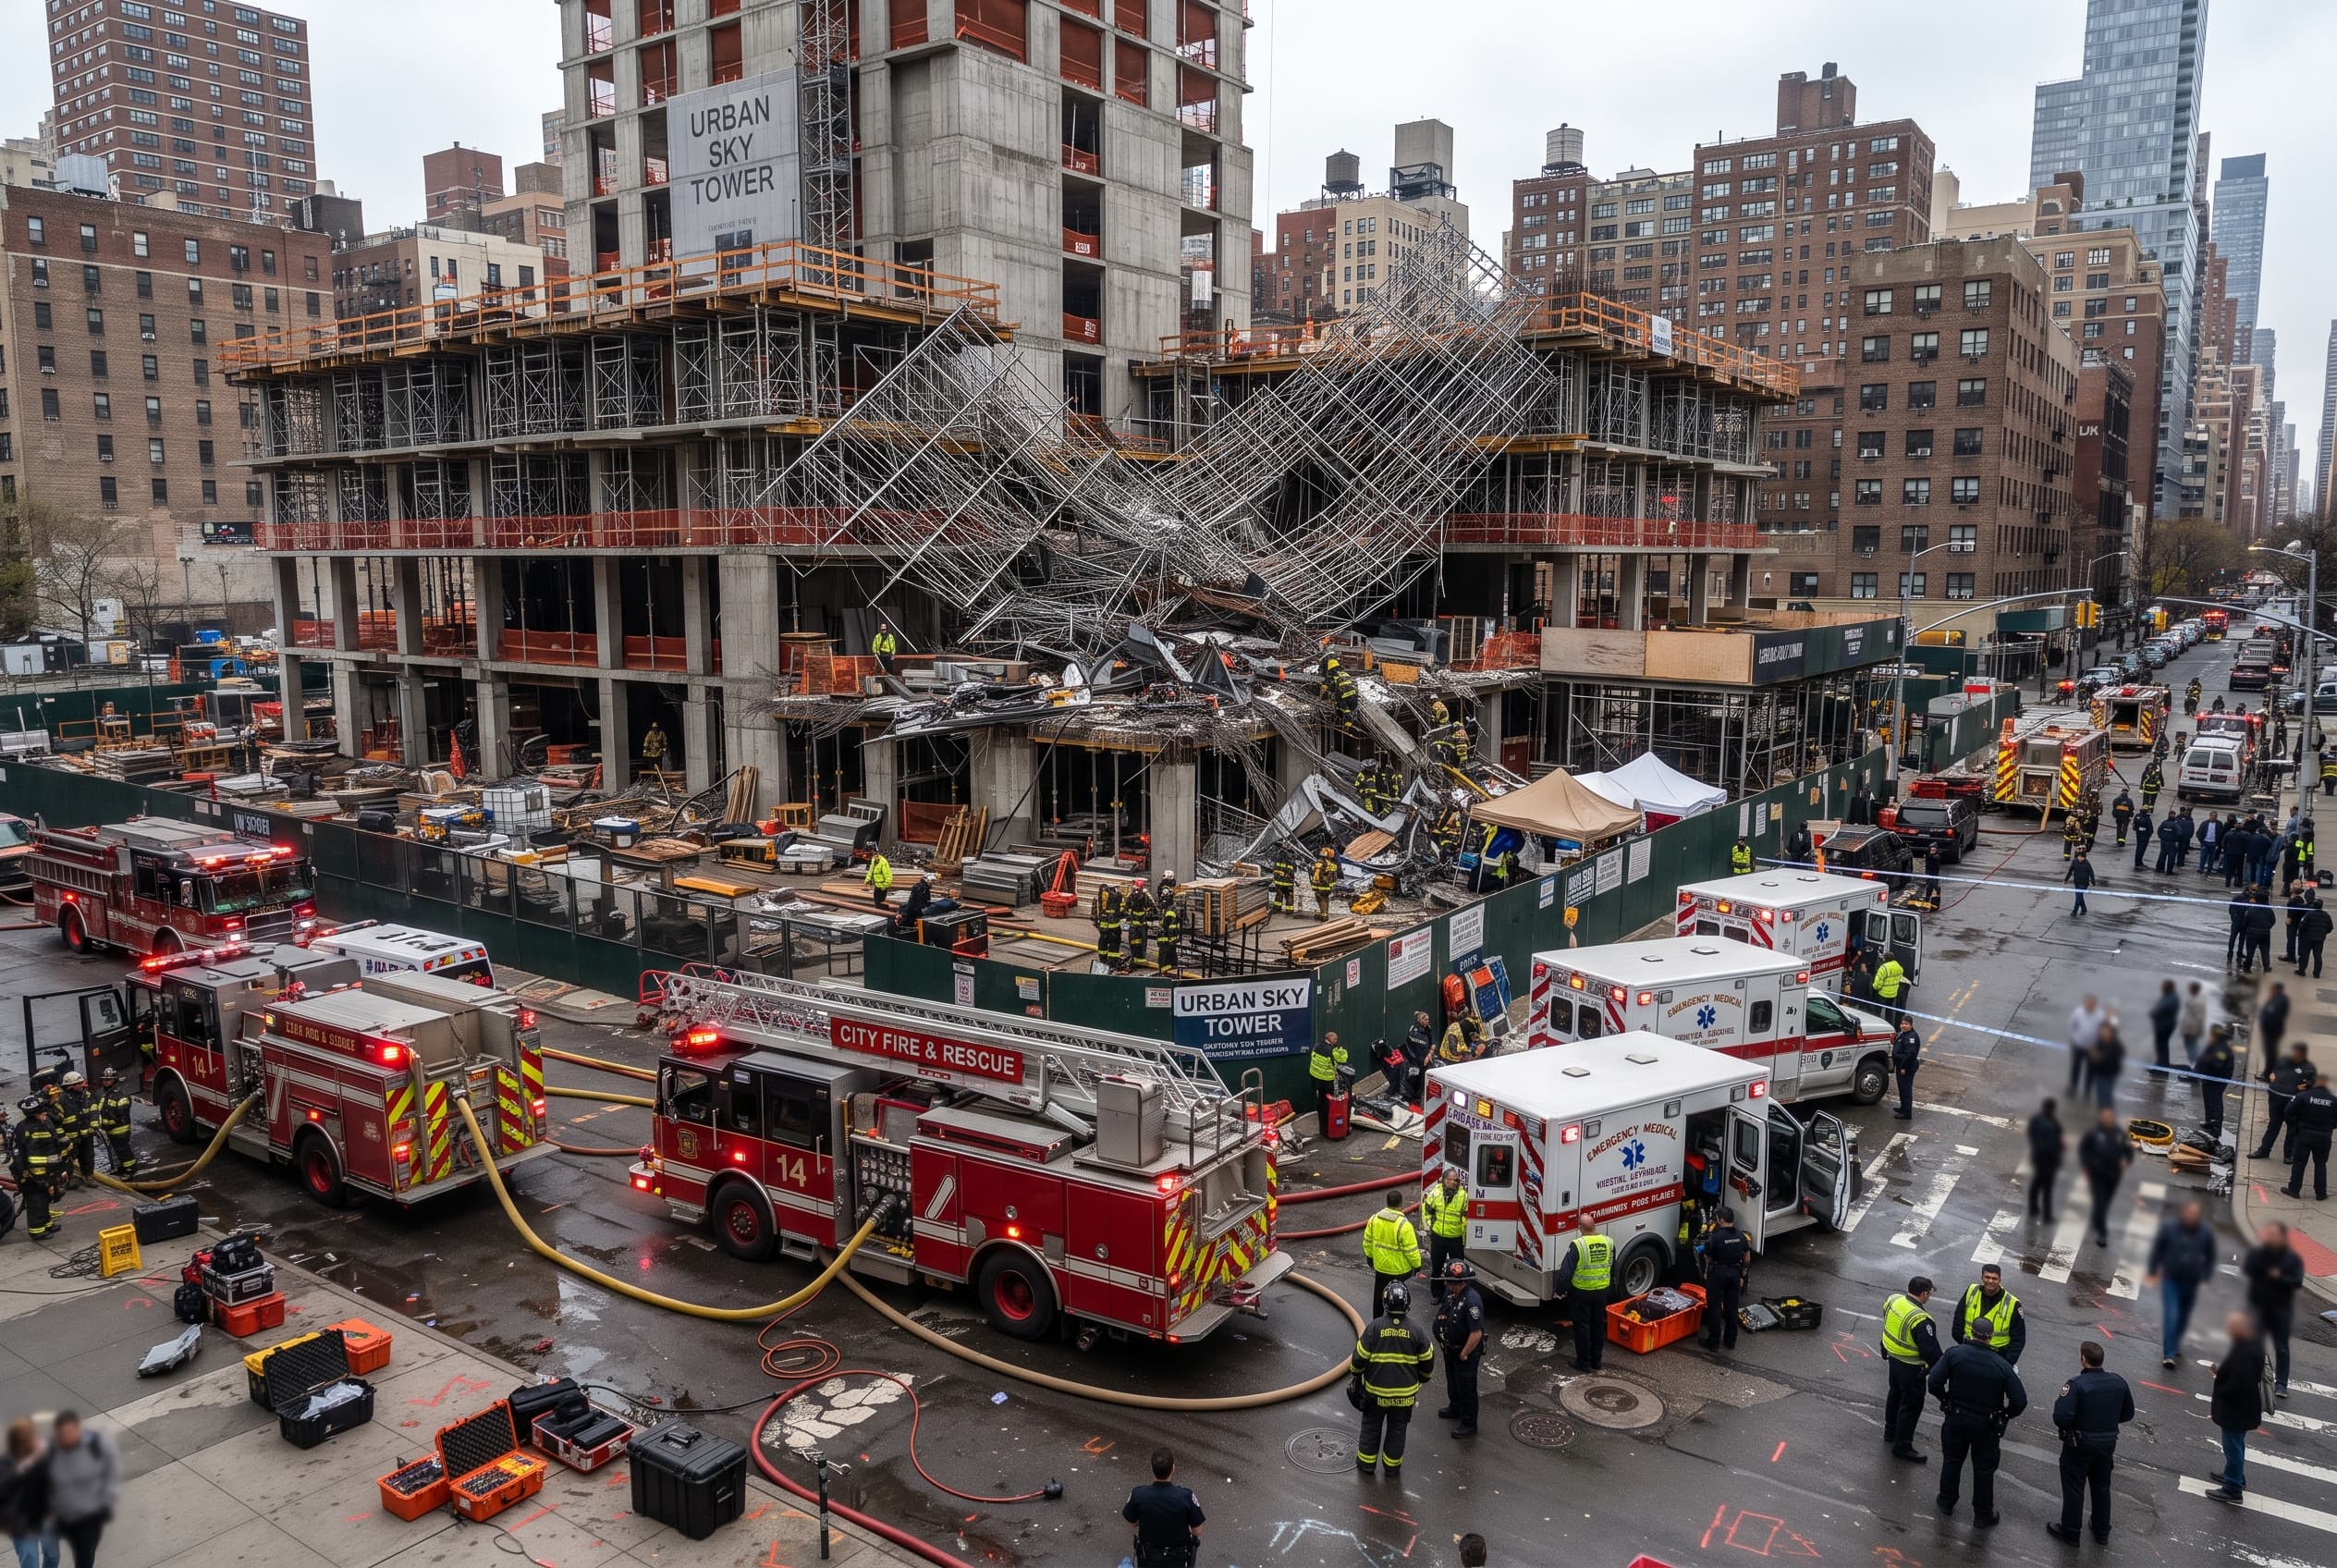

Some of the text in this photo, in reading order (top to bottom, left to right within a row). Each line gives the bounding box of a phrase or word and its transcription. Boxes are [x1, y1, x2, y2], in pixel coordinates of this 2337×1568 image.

[691, 94, 770, 138] URBAN
[709, 132, 753, 167] SKY
[690, 165, 775, 205] TOWER
[1181, 991, 1255, 1012] URBAN
[1263, 987, 1304, 1007] SKY
[1205, 1014, 1283, 1036] TOWER
[192, 1055, 207, 1079] 14
[839, 1025, 1015, 1076] CITY FIRE & RESCUE
[1586, 1122, 1678, 1162] EMERGENCY MEDICAL
[777, 1154, 807, 1188] 14
